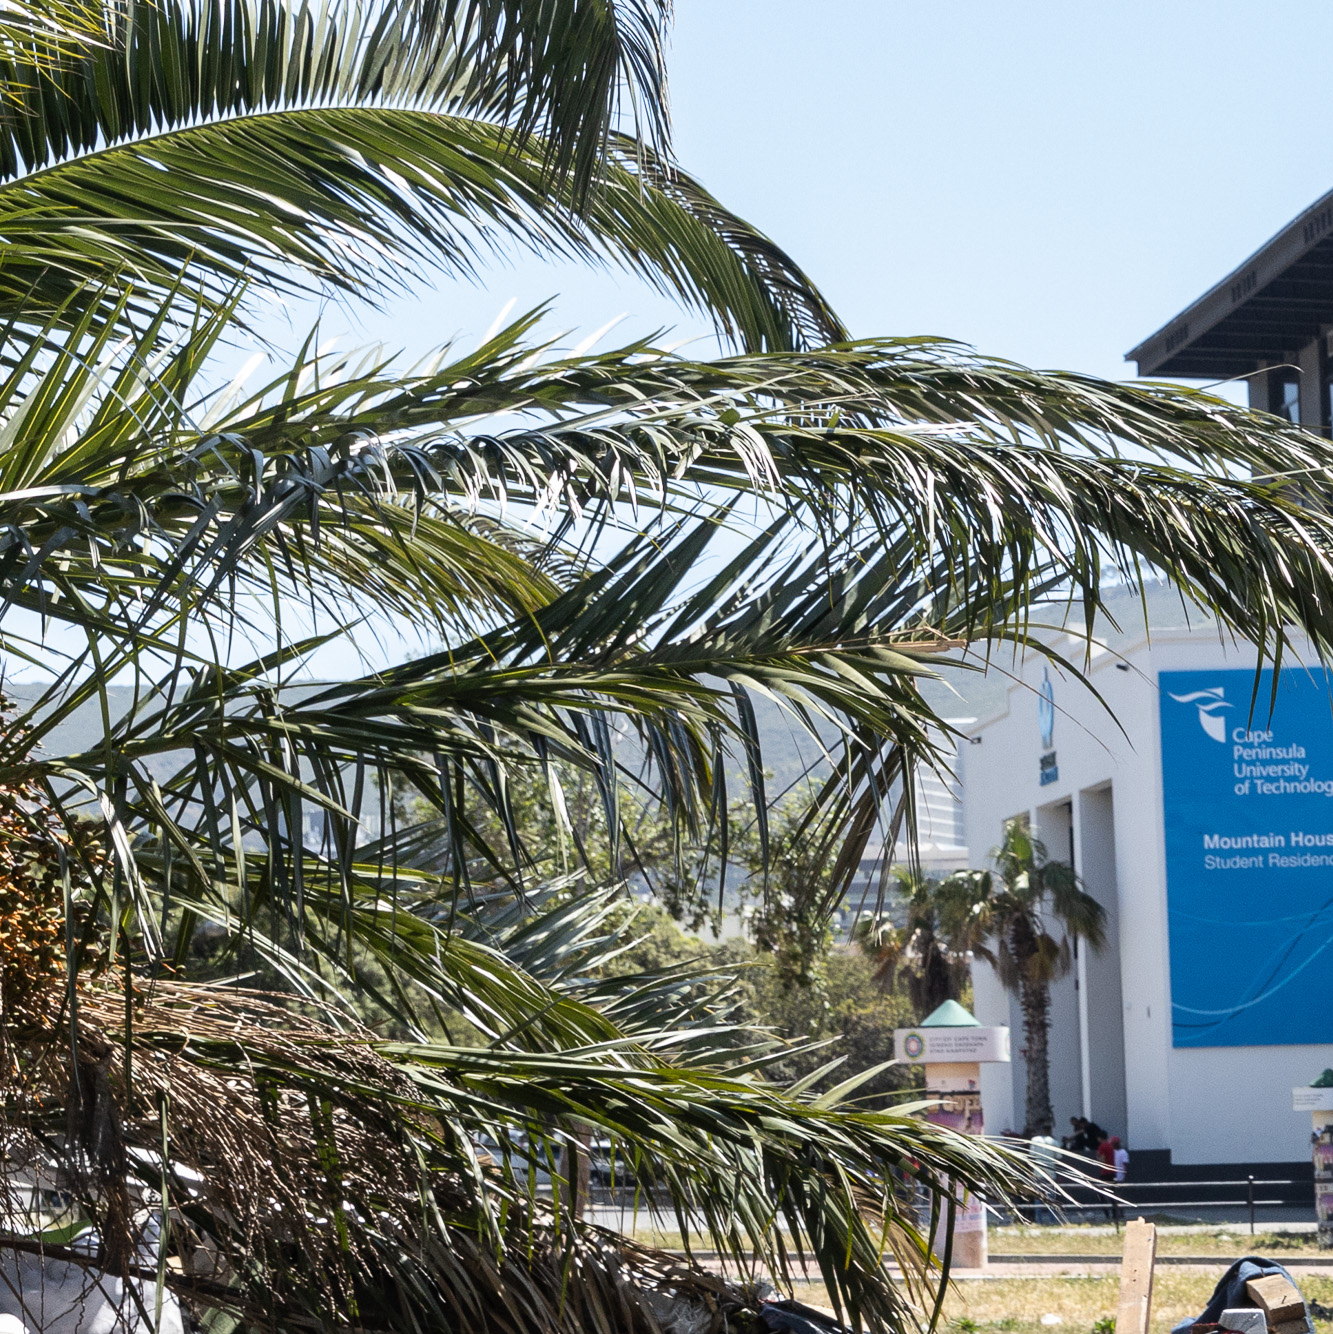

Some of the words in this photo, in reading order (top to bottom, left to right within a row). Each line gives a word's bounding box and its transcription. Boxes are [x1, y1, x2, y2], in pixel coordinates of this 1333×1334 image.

[1233, 727, 1273, 745] Cape
[1233, 743, 1306, 760] Peninsula
[1233, 761, 1309, 780] University
[1234, 780, 1250, 795] of
[1203, 833, 1285, 850] Mountain
[1204, 855, 1264, 870] Student
